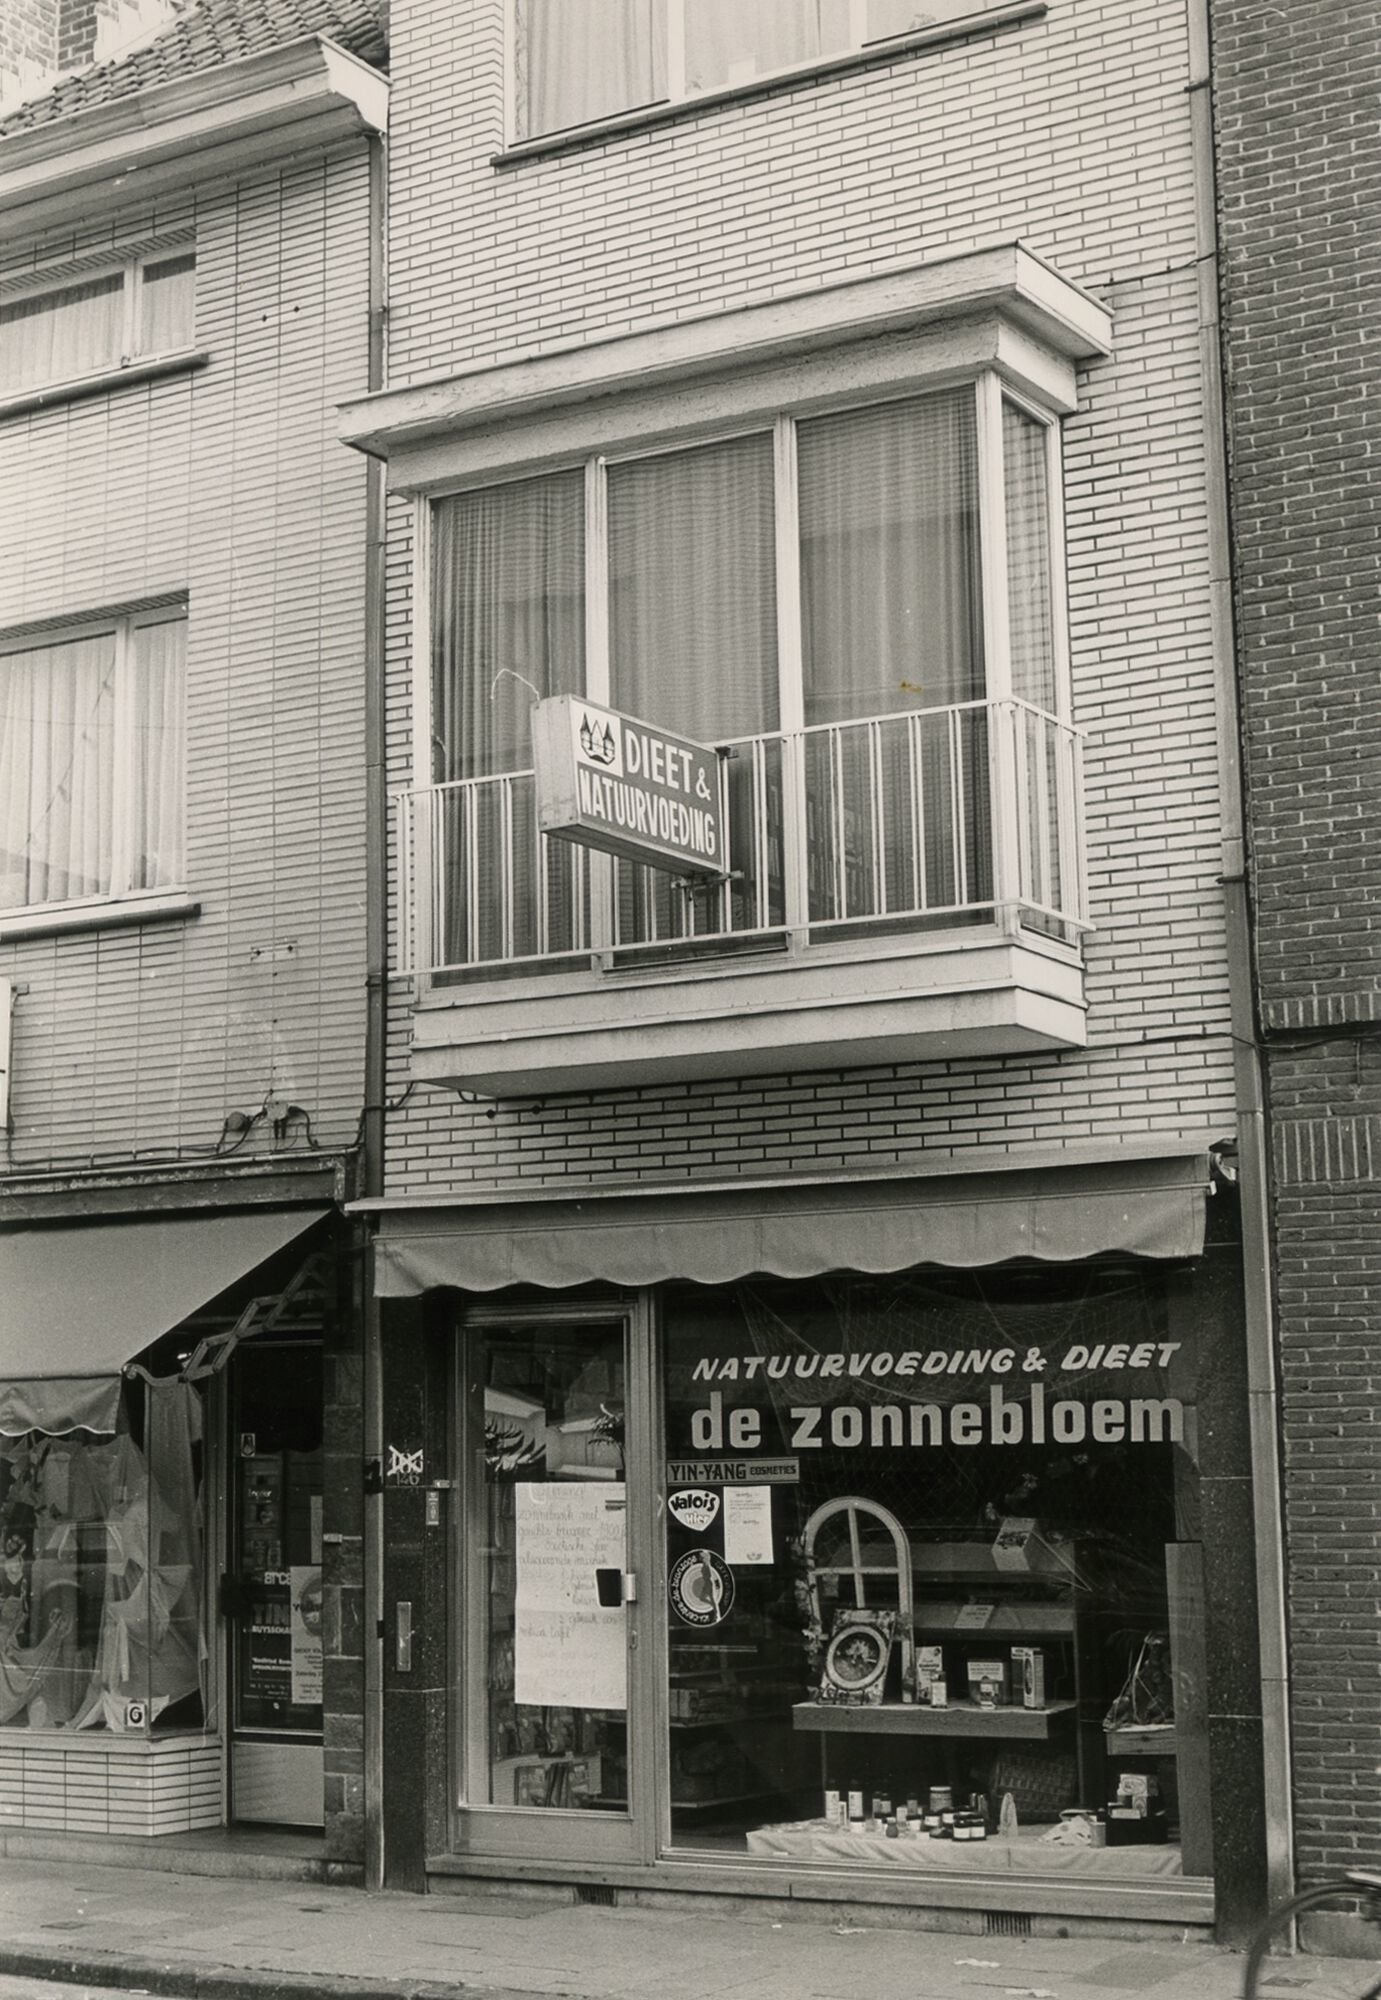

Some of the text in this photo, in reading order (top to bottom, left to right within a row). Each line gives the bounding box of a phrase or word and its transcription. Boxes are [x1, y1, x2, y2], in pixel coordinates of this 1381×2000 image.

[625, 728, 712, 801] DIEET &
[579, 768, 716, 856] NATUURVOEDING
[692, 1342, 1182, 1381] NATUURVOEDING & DIEET
[691, 1382, 1184, 1450] de zonnebloem
[670, 1463, 747, 1481] YIN-YANG
